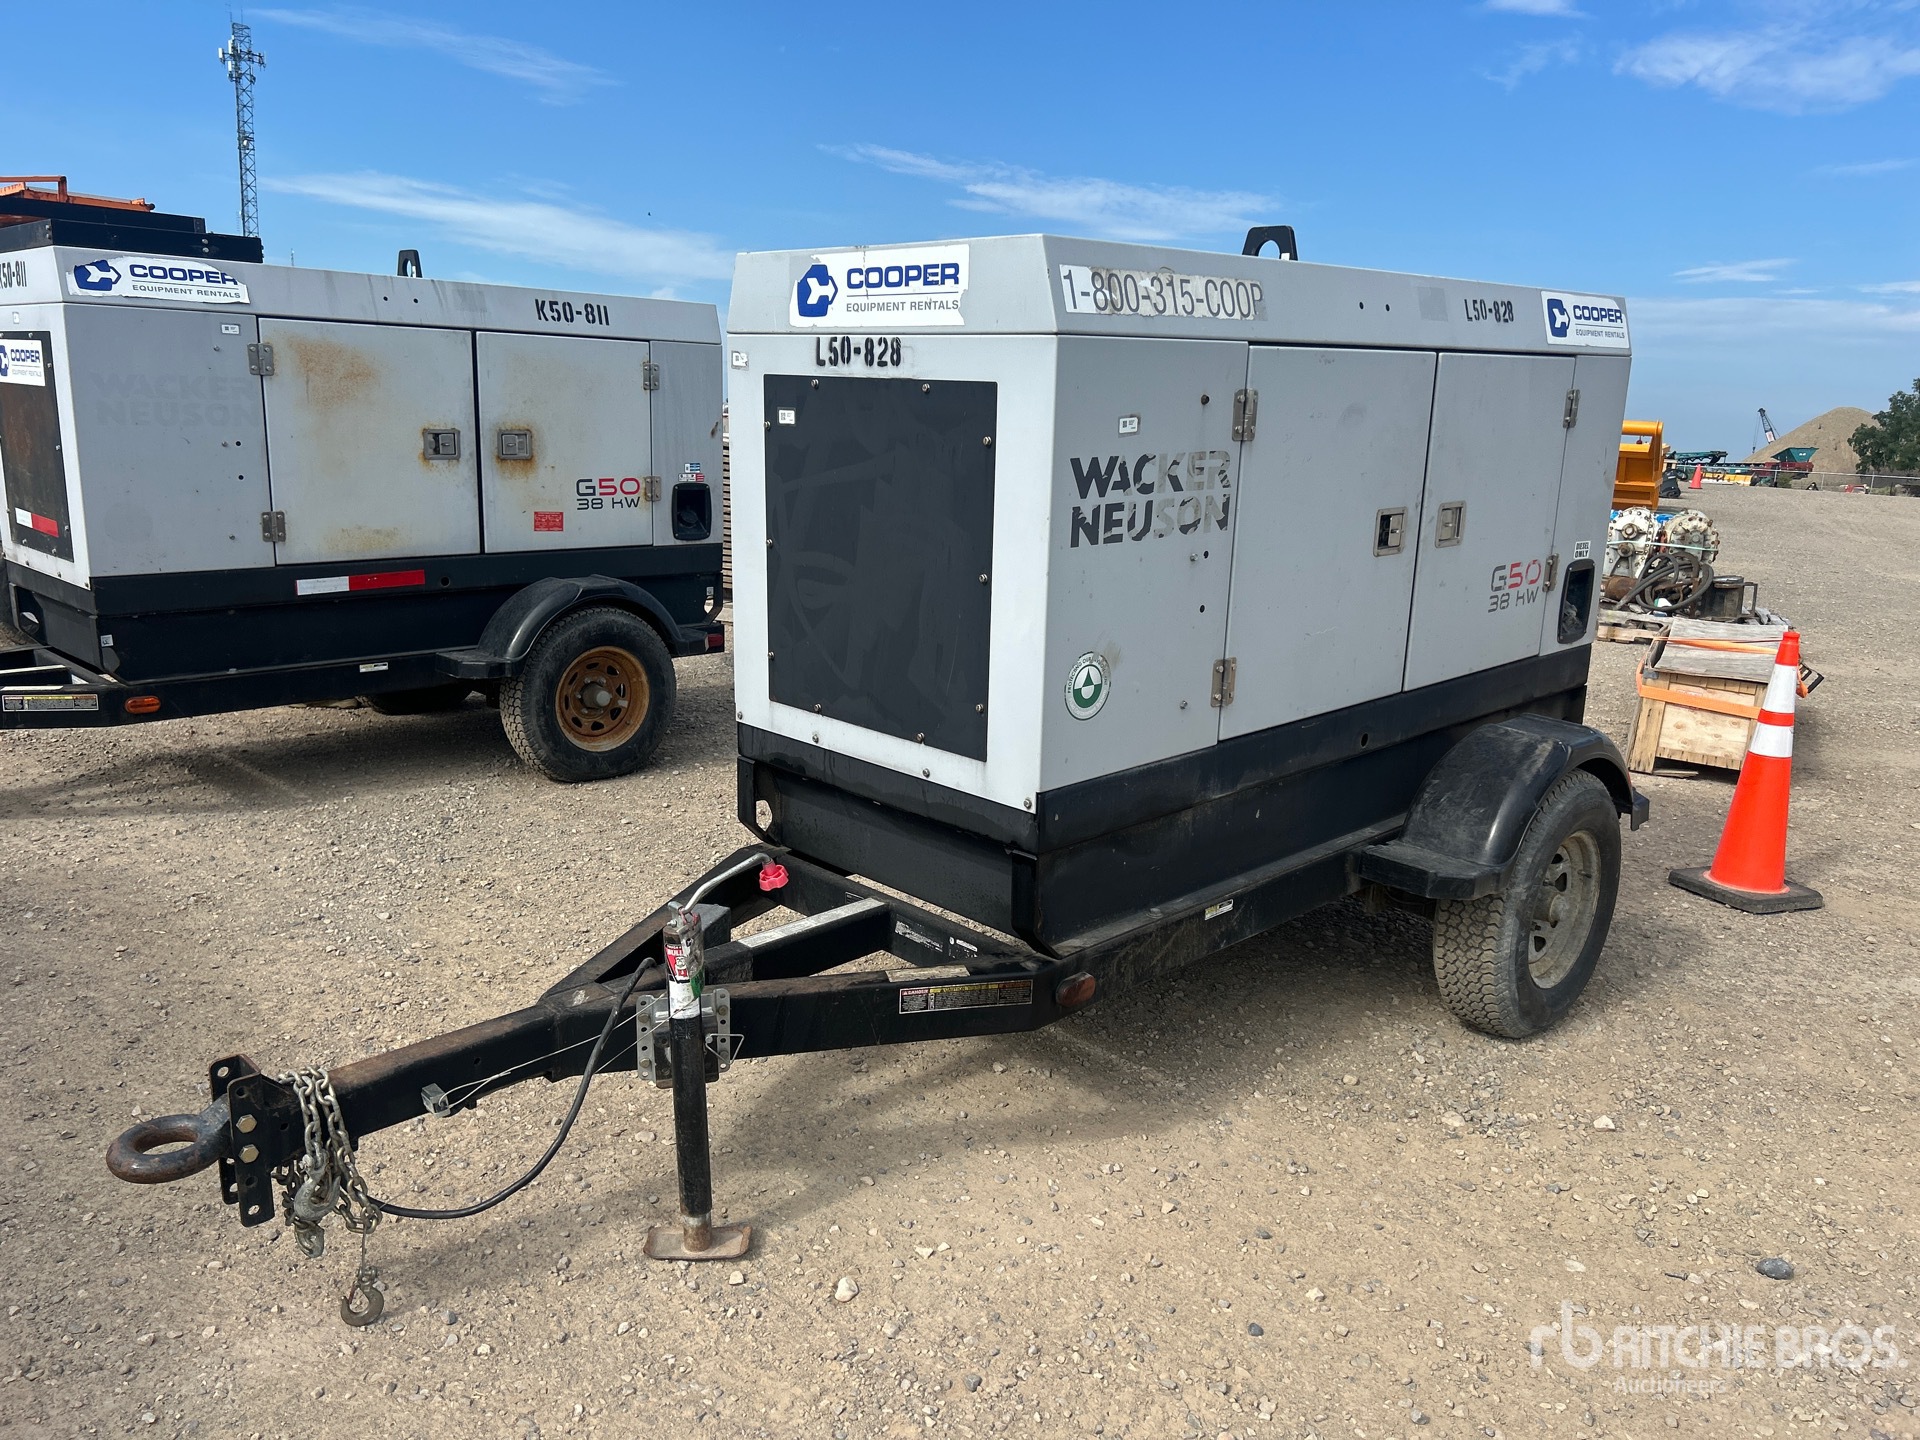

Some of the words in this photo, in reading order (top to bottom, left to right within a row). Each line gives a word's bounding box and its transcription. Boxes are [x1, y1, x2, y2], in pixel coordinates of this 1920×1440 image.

[129, 264, 239, 285] COOPER
[847, 262, 960, 290] COOPER
[132, 284, 193, 296] EQUIPMENT
[196, 289, 241, 299] RENTALS
[534, 298, 610, 326] K50-811
[846, 301, 906, 313] EQUIPMENT
[909, 299, 959, 312] RENTALS
[1463, 299, 1514, 324] L50-828
[1572, 304, 1623, 324] COOPER
[1575, 328, 1604, 338] EQUIPMENT
[1604, 330, 1625, 339] RENTALS
[10, 348, 41, 363] COOPER
[816, 336, 902, 368] L50-828
[1070, 450, 1232, 499] WACKER
[576, 477, 641, 497] G50
[576, 498, 604, 511] 38
[1070, 494, 1231, 548] NEUSON
[1490, 559, 1542, 592] G50
[1487, 592, 1510, 613] 38
